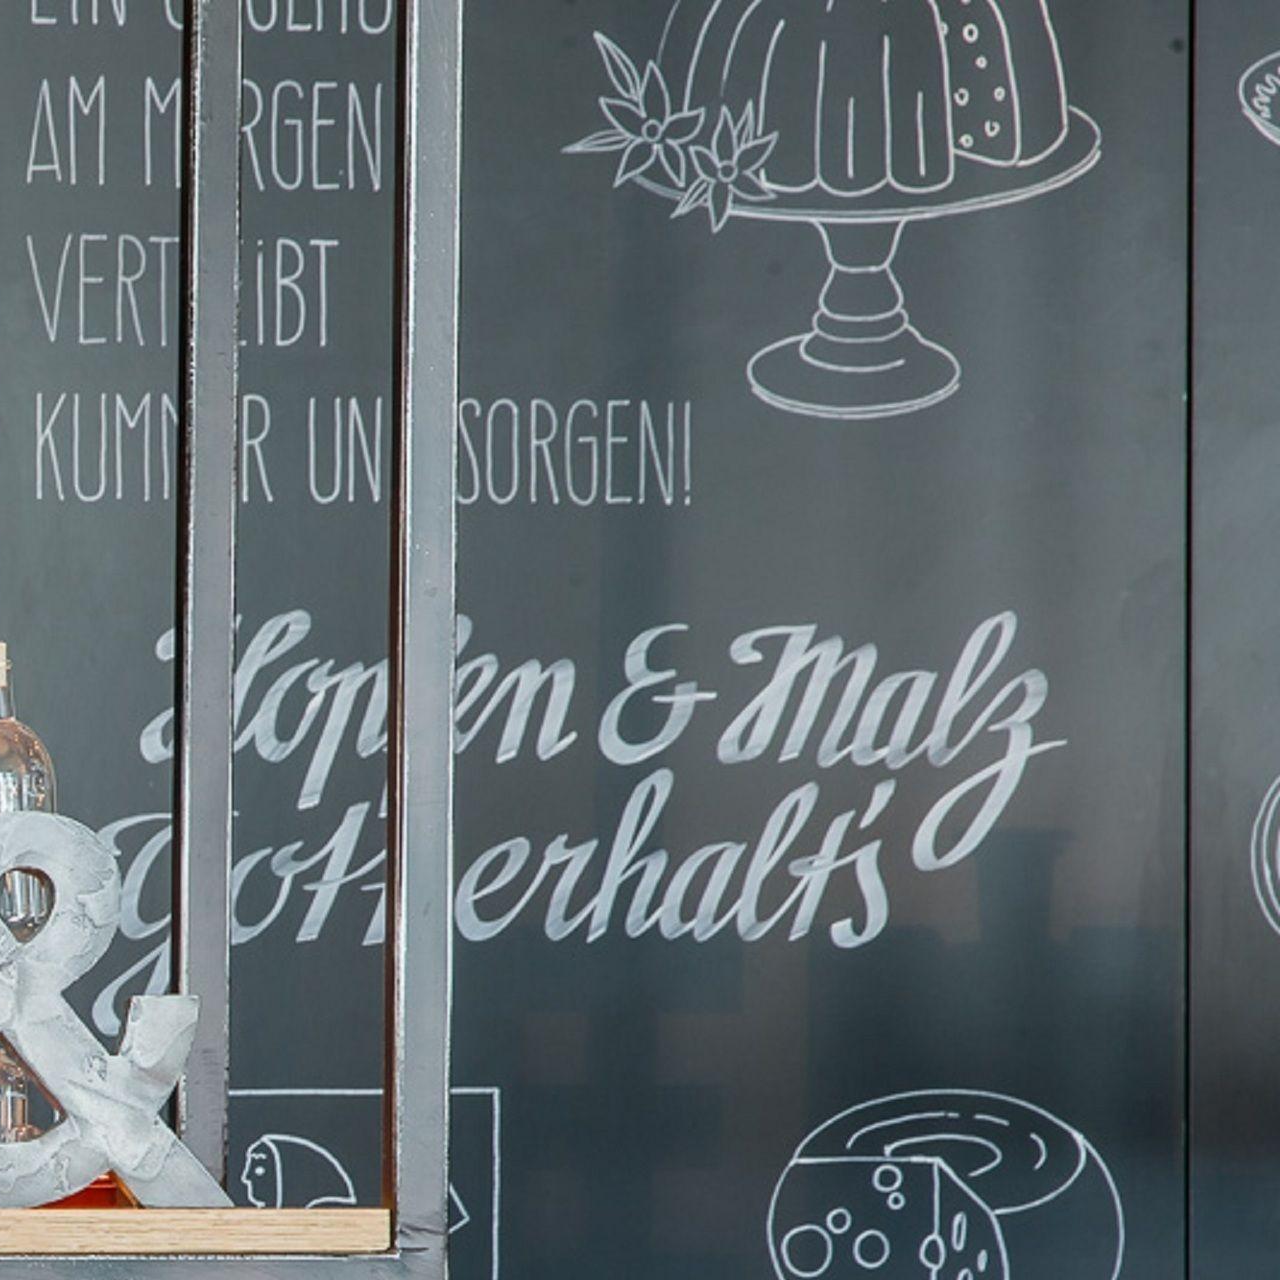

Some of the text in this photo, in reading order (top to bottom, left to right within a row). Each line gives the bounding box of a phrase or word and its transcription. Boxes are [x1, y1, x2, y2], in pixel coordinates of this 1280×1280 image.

[27, 76, 383, 192] AM MRGEN
[308, 396, 383, 504] UN
[456, 398, 691, 506] SORGEN!
[598, 623, 718, 765] &
[716, 609, 1068, 872] Malz
[455, 768, 897, 949] erhalt's
